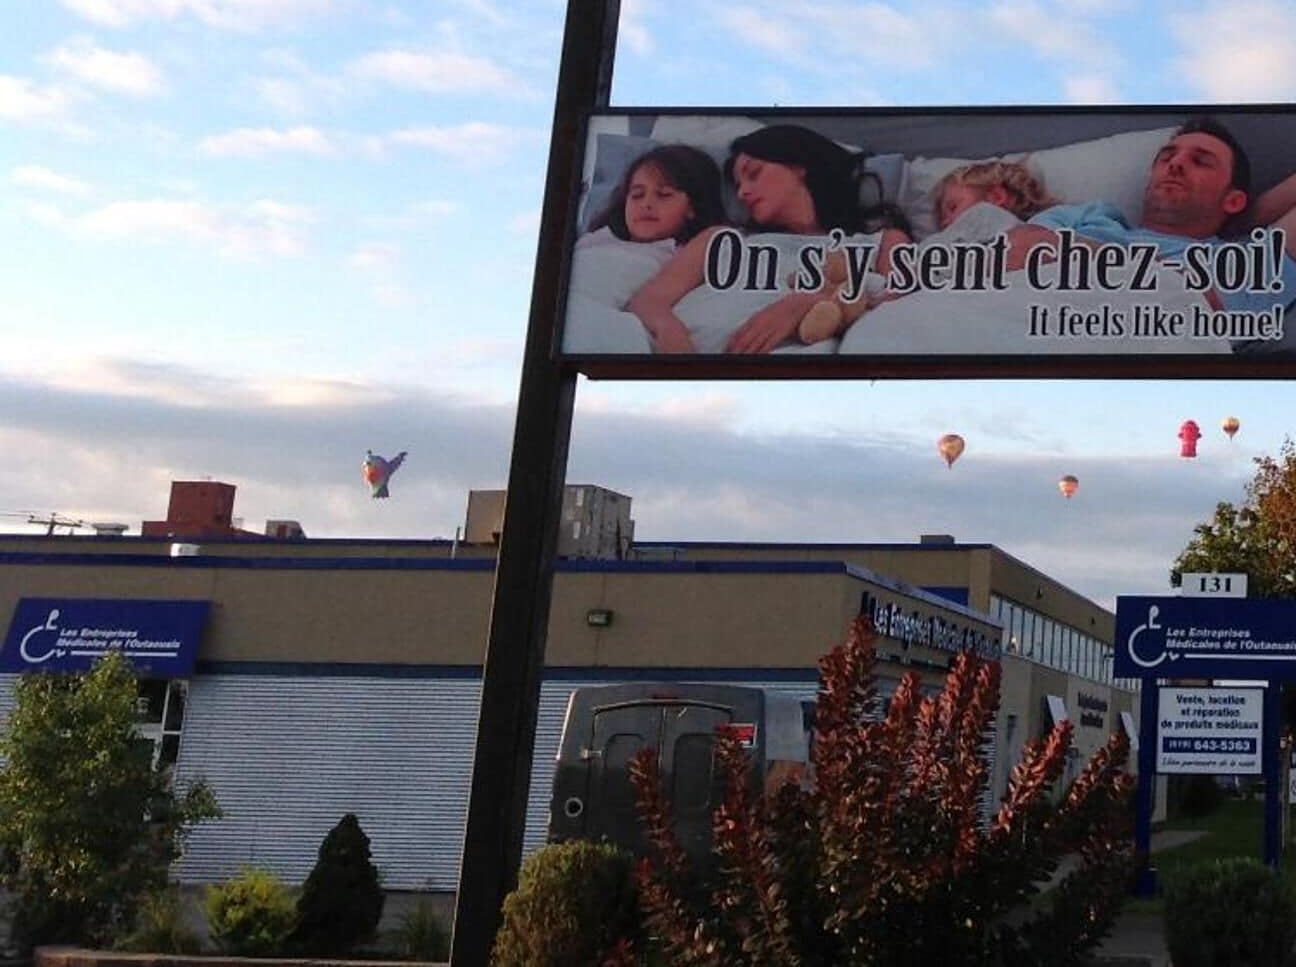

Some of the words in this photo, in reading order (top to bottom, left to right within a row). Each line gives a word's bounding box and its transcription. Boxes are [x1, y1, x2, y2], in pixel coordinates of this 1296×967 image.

[706, 229, 779, 291] On
[797, 230, 875, 301] s'y
[889, 231, 1010, 291] sent
[1026, 229, 1285, 292] chez-soi!
[1028, 304, 1049, 337] It
[1057, 304, 1125, 337] feels
[1133, 304, 1184, 337] like
[1192, 304, 1285, 338] home!
[1199, 577, 1233, 593] 131
[1165, 627, 1186, 637] Les
[1188, 627, 1251, 639] Entreprises
[1223, 640, 1238, 650] de
